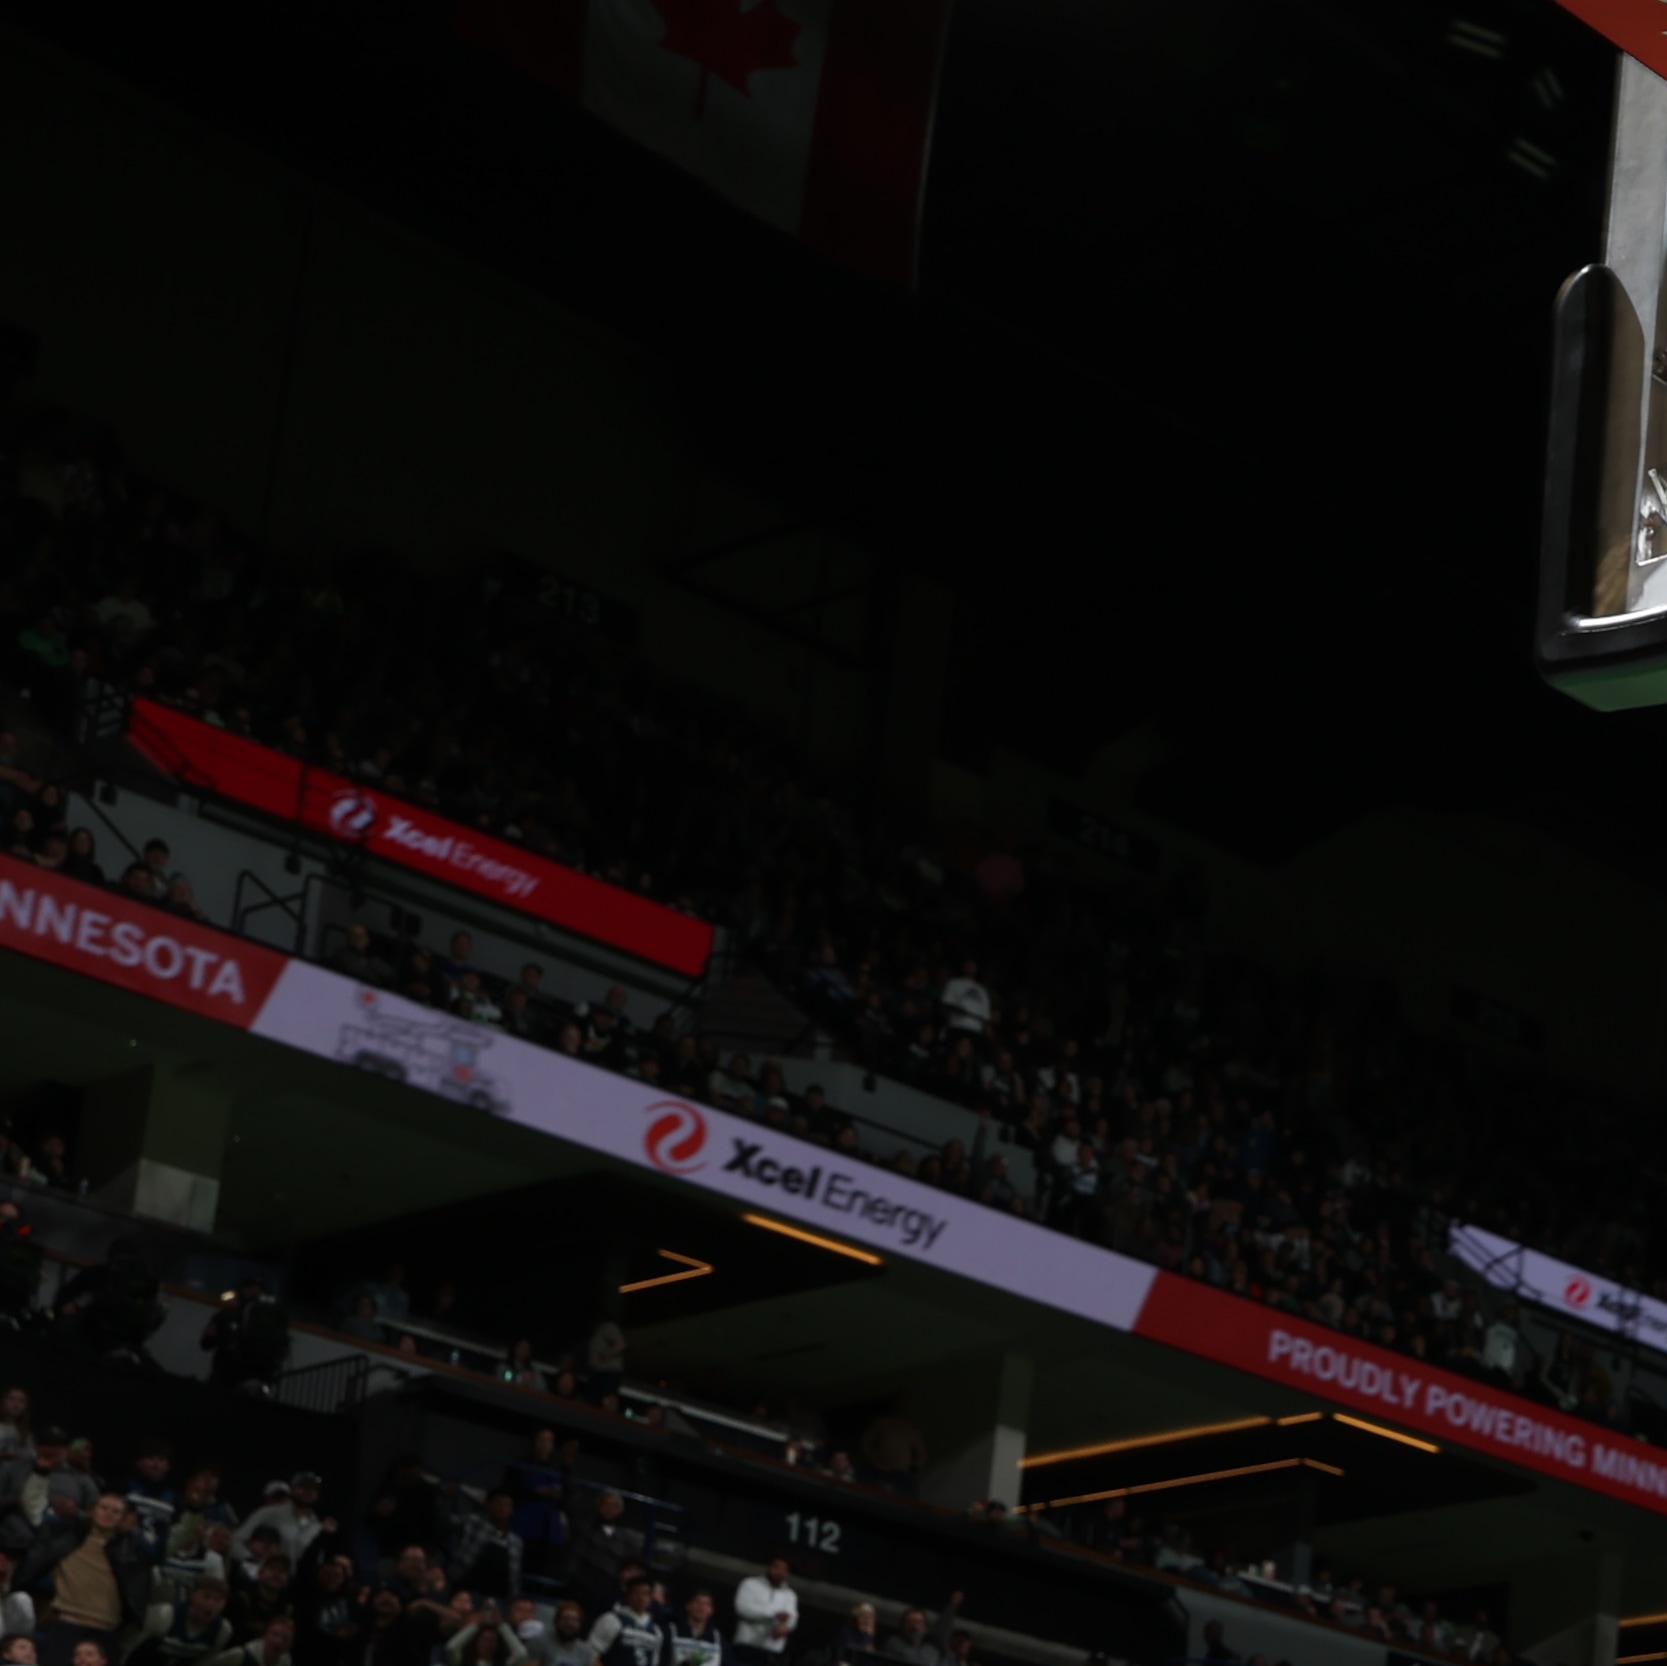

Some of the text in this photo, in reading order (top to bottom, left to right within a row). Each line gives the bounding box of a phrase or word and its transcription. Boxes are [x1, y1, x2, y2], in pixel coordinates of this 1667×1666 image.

[385, 811, 456, 864] Xcel
[722, 1136, 948, 1251] Xcel Energy
[1269, 1329, 1422, 1410] PROUDLY
[1425, 1382, 1586, 1468] POWERING
[783, 1512, 842, 1554] 112
